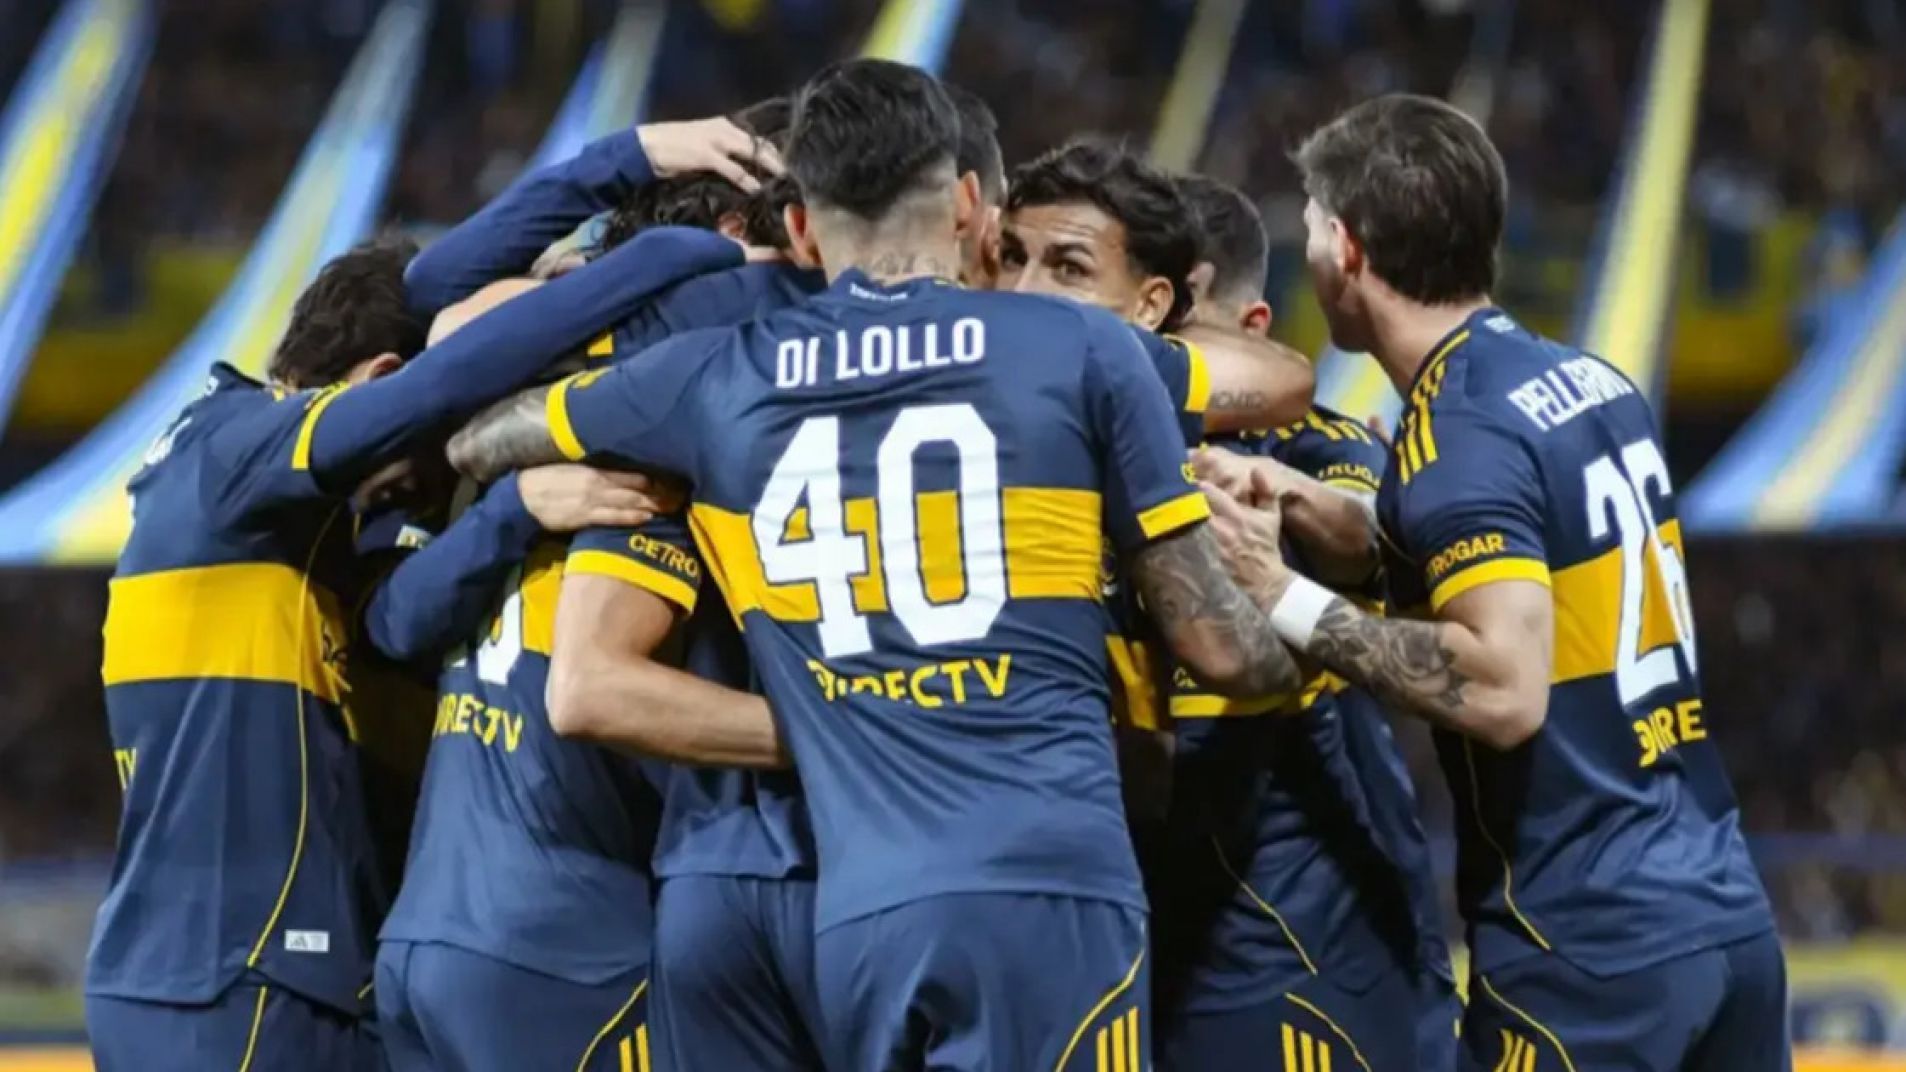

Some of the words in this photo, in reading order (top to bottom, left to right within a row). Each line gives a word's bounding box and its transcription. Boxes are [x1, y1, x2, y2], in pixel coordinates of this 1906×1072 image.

[776, 337, 820, 389] DI
[836, 317, 985, 380] LOLLO
[629, 533, 698, 578] CETRO
[752, 403, 1007, 658] 40
[1428, 532, 1505, 576] ROGAR
[1584, 438, 1698, 707] 26
